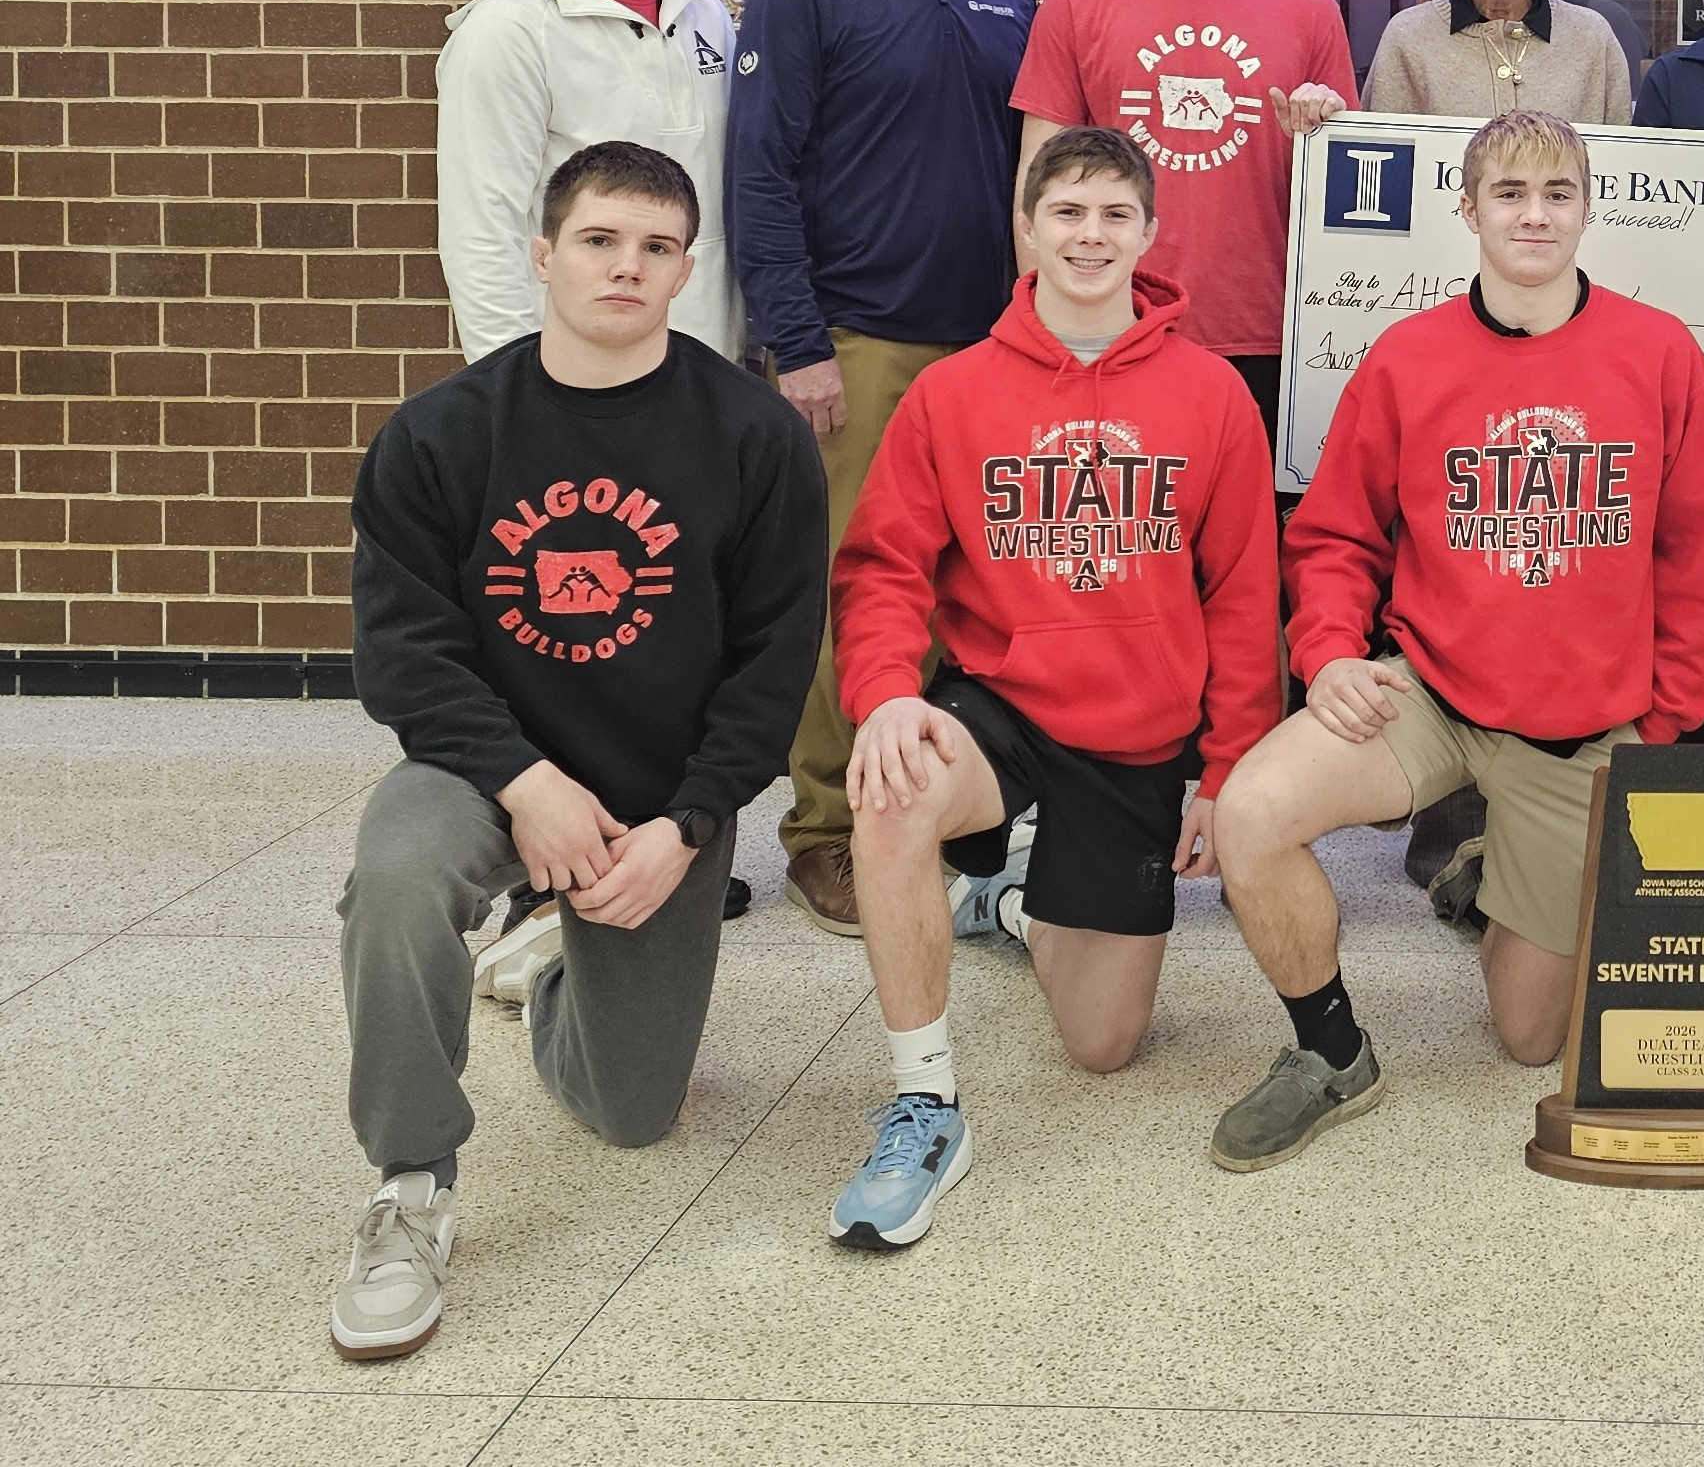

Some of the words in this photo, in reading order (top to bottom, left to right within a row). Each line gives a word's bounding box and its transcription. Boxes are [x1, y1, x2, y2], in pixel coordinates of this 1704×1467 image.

[1136, 24, 1262, 80] ALGONA
[1128, 119, 1249, 172] WRESTLING
[1433, 160, 1465, 192] IO
[1335, 270, 1366, 290] Pay
[1367, 275, 1381, 290] to
[1304, 291, 1325, 307] the
[1326, 292, 1363, 308] Order
[1364, 294, 1382, 313] of
[1035, 427, 1065, 451] ALGONA
[1064, 419, 1105, 431] BULLDOS
[1105, 423, 1131, 444] CLASS
[1489, 417, 1517, 441] ALGONA
[1554, 408, 1578, 430] CLASS
[982, 455, 1189, 524] STATE
[1444, 441, 1636, 514] STATE
[490, 477, 680, 559] ALGONA
[1444, 509, 1632, 551] WRESTLING
[984, 519, 1184, 560] WRESTLING
[1056, 560, 1073, 575] 20
[1099, 558, 1118, 573] 26
[1509, 553, 1525, 569] 20
[1547, 551, 1561, 567] 26
[497, 607, 654, 663] BULLDOGS
[1635, 888, 1673, 897] ATHLETIC
[1642, 879, 1666, 888] IOWA
[1666, 879, 1687, 888] HIGH
[1597, 963, 1694, 983] SEVENTH
[1637, 1039, 1679, 1051] DUAL
[1665, 1025, 1697, 1037] 2026
[1656, 1067, 1690, 1077] CLASS
